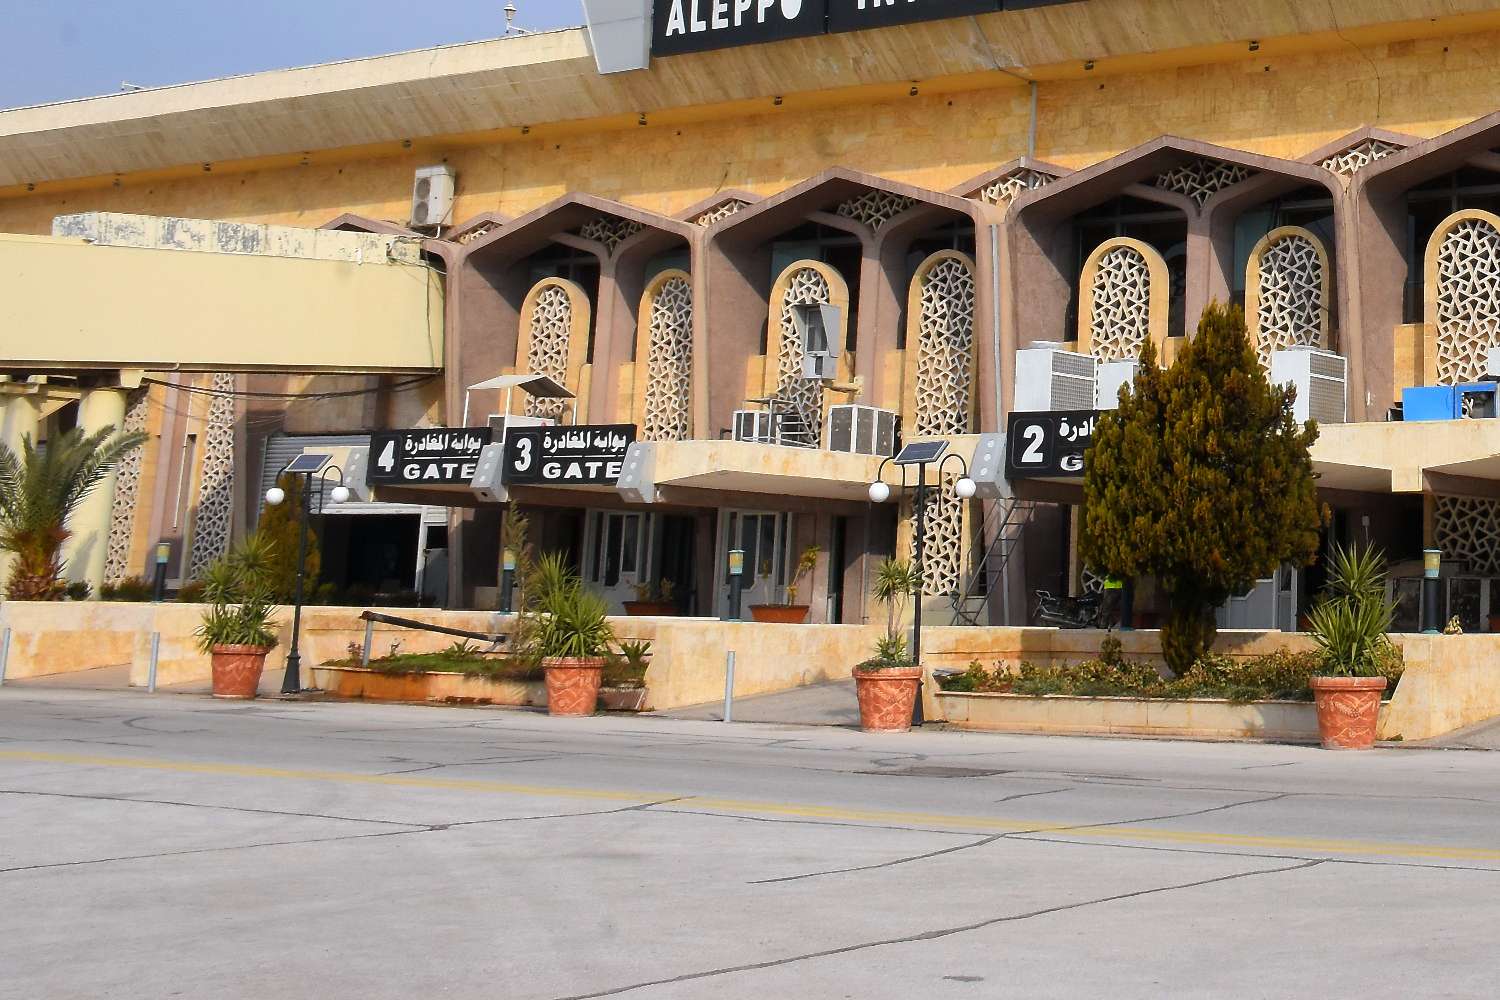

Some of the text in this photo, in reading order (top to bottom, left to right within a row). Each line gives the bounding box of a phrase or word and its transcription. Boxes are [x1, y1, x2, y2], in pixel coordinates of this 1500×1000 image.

[404, 432, 482, 455] بوابة المغادرة
[543, 431, 626, 454] بوابة المغادرة
[1021, 425, 1045, 463] 2
[378, 440, 395, 472] 4
[514, 437, 532, 472] 3
[403, 463, 475, 480] GATE
[542, 461, 622, 479] GATE
